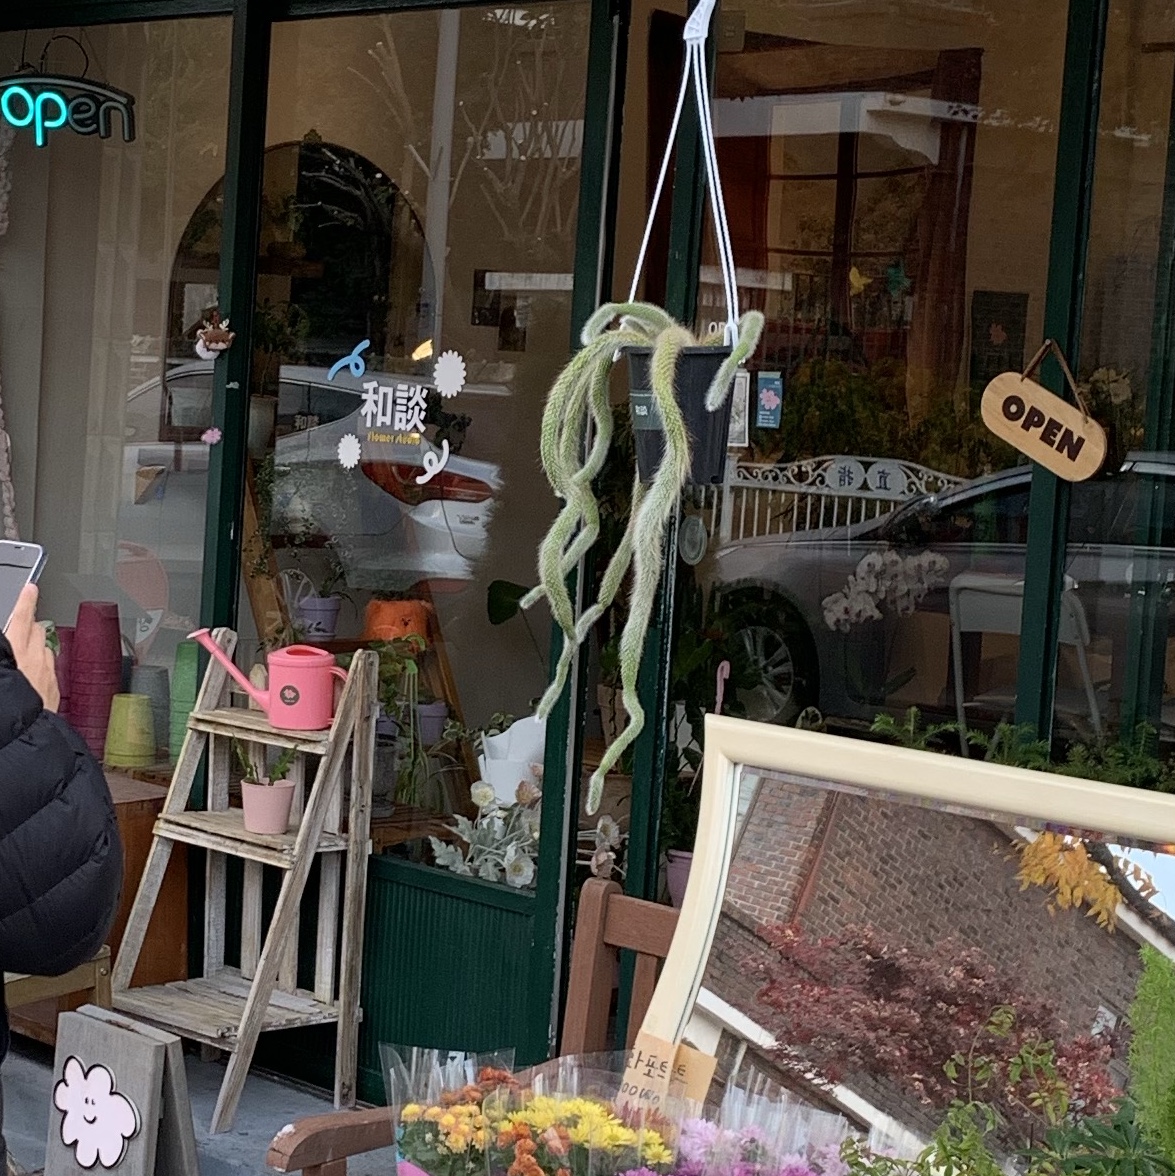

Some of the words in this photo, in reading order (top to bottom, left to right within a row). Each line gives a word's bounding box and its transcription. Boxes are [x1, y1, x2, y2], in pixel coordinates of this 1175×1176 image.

[1, 86, 133, 147] open
[361, 381, 428, 433] 和談
[1002, 395, 1086, 463] OPEN
